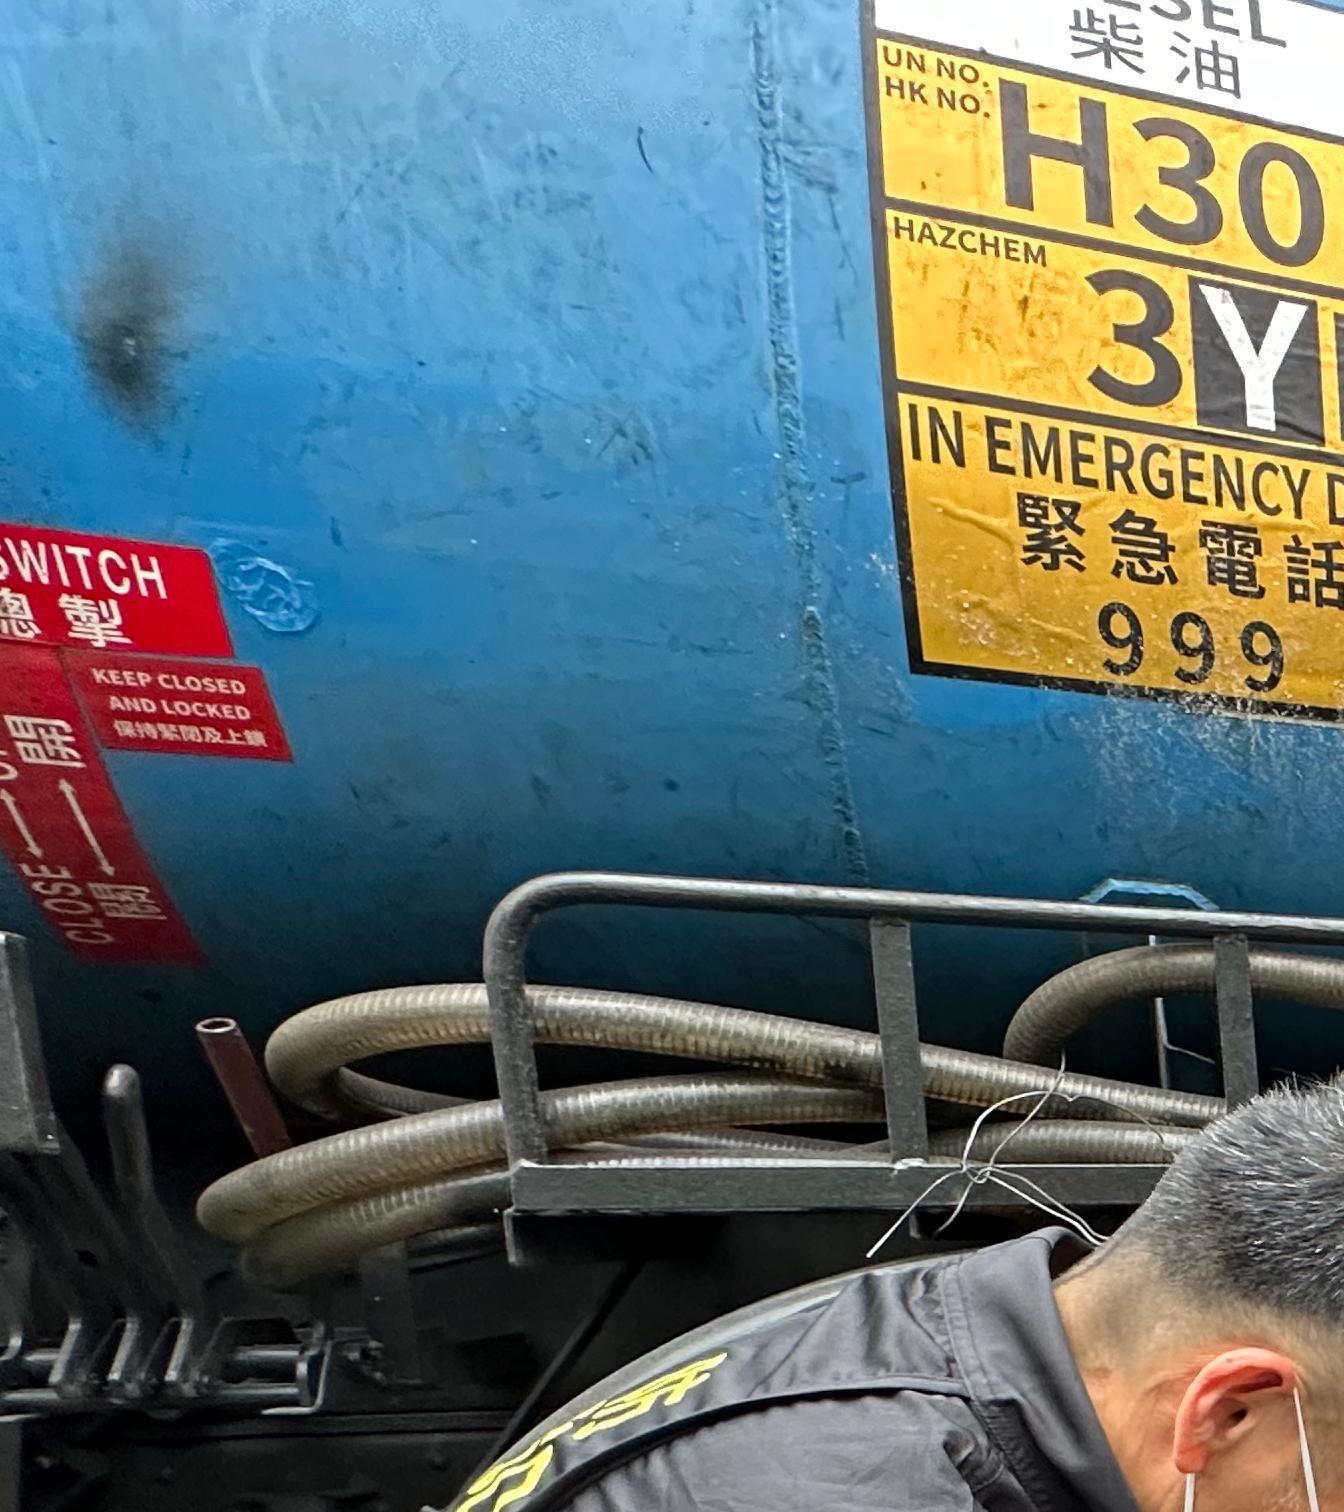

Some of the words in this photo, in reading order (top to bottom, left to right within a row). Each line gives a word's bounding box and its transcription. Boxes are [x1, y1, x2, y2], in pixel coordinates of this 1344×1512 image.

[883, 46, 926, 74] UN
[936, 57, 989, 88] NO.
[1069, 8, 1241, 99] 柴油
[885, 76, 928, 105] HK
[937, 87, 990, 118] NO.
[893, 216, 1048, 267] HAZCHEM
[909, 403, 966, 468] IN
[987, 415, 1308, 520] EMERGENCY
[1098, 601, 1285, 693] 999
[92, 667, 151, 688] KEEP
[158, 673, 246, 695] CLOSED
[109, 695, 157, 714] AND
[161, 699, 251, 721] LOCKED
[3, 714, 87, 769] 開
[19, 862, 115, 945] CLOSE
